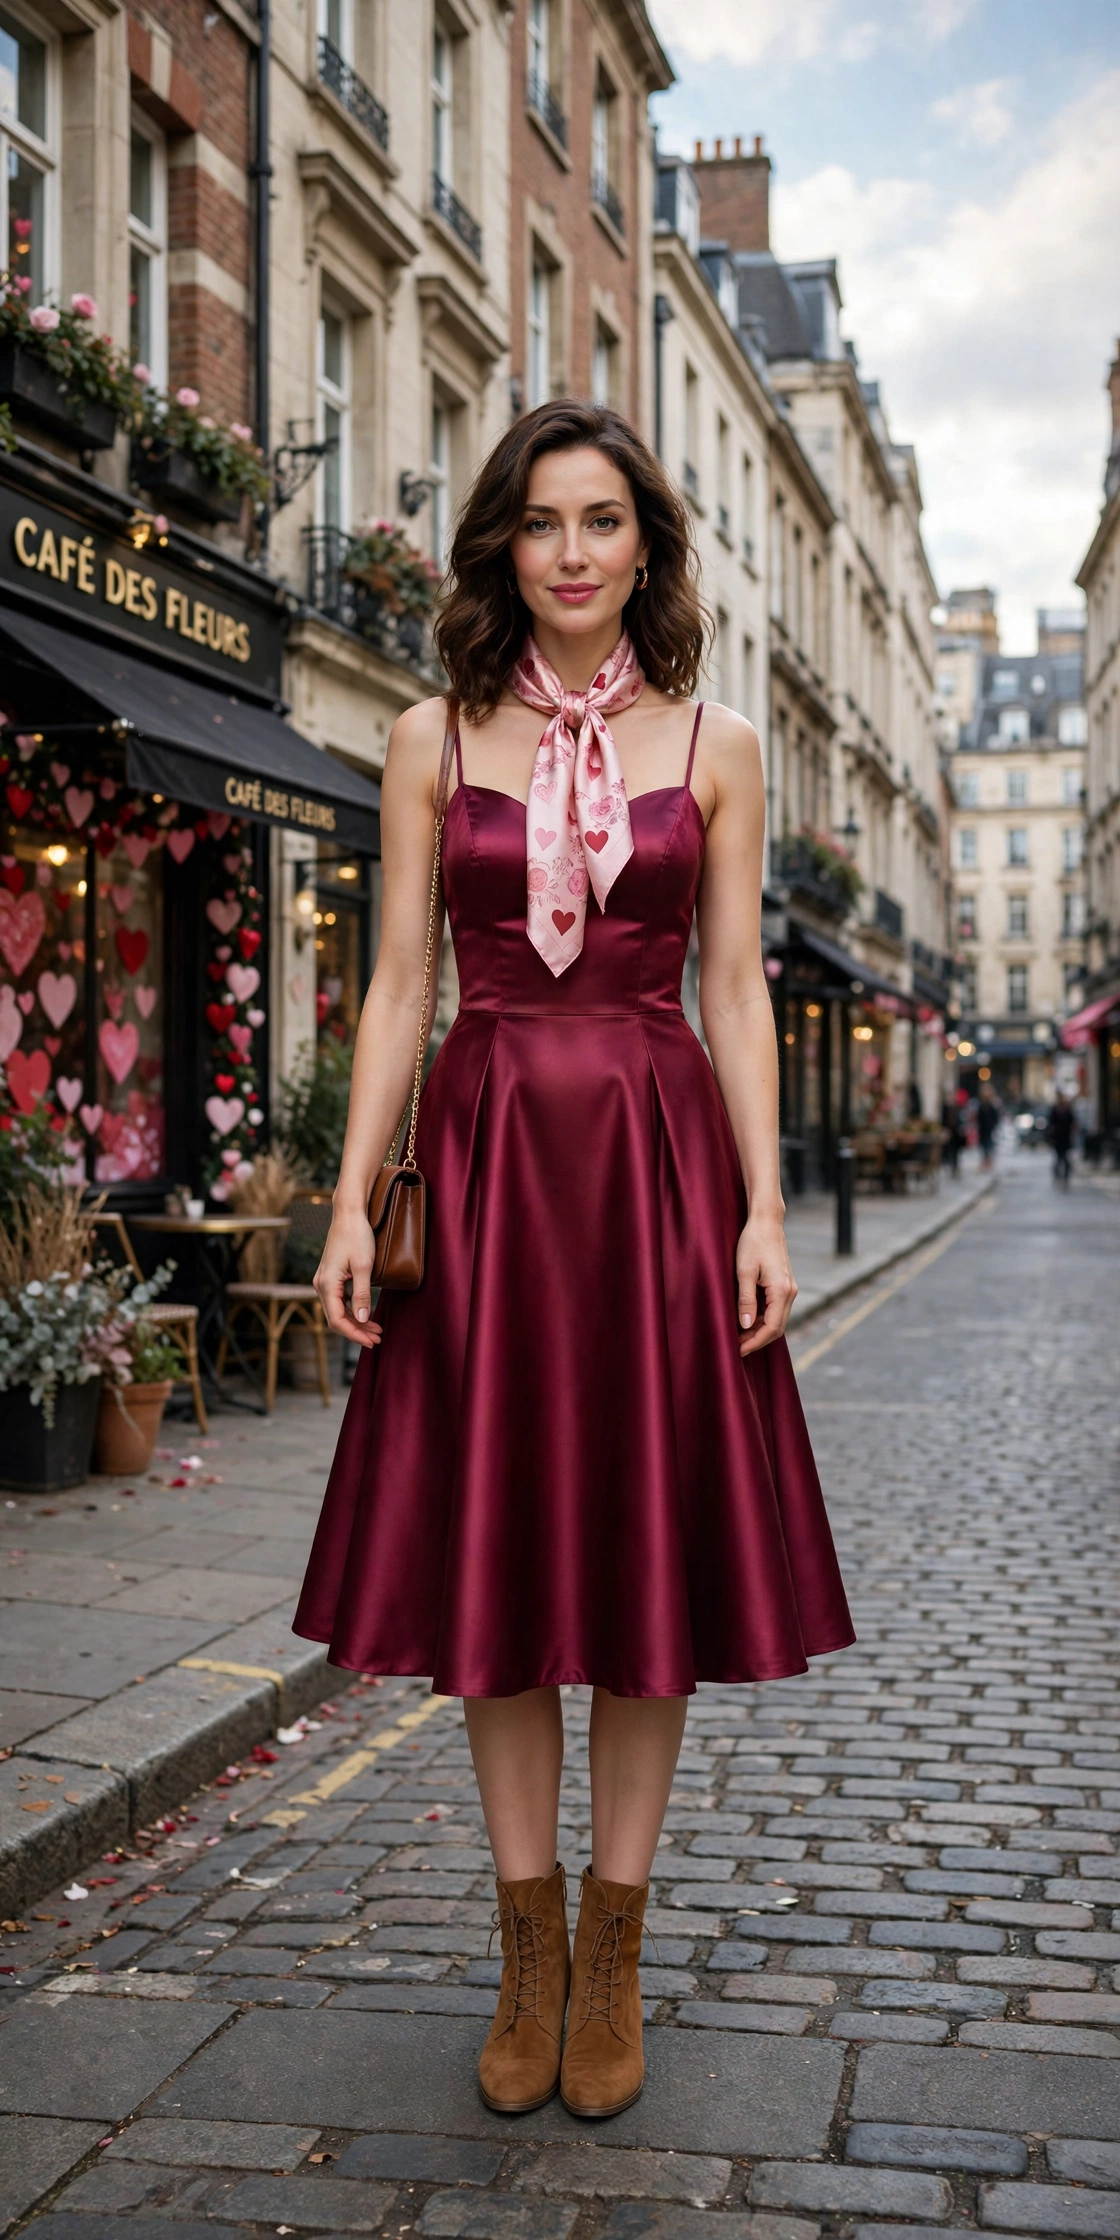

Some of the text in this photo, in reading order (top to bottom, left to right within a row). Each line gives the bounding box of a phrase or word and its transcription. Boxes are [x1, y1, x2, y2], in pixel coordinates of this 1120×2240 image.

[14, 517, 251, 663] CAFÉ DES FLEURS
[225, 777, 336, 832] CAFÉ DES FLEURS
